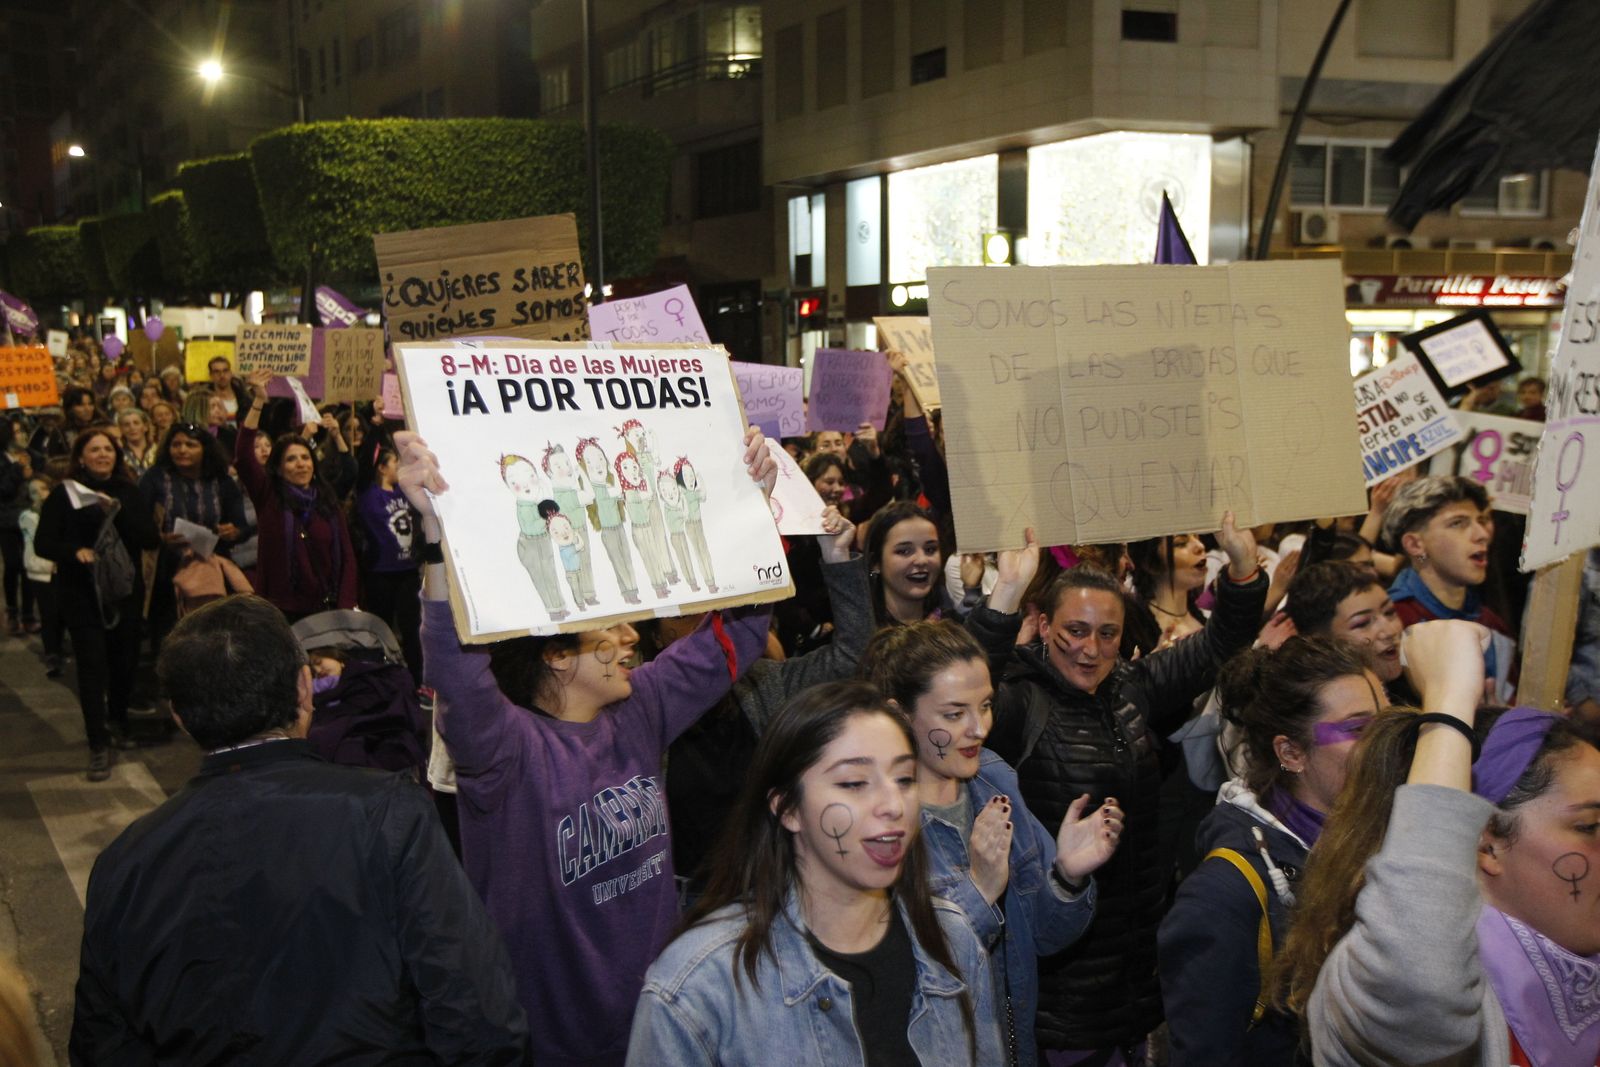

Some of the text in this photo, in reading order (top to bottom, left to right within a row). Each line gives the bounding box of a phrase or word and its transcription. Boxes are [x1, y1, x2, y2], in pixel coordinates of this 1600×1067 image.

[512, 262, 580, 293] SABER
[511, 291, 587, 326] SOMOS
[942, 280, 1069, 330] SOMOS
[1083, 296, 1137, 328] LAS
[249, 343, 273, 351] CASA
[605, 319, 658, 342] TODAS
[440, 354, 703, 378] 8-M: Día de las Mujeres
[990, 345, 1304, 384] DE LAS BRUJAS QUE
[446, 379, 490, 416] ¡A
[497, 377, 581, 414] POR
[584, 376, 712, 412] TODAS!
[1016, 406, 1061, 452] NO
[1050, 455, 1253, 526] QUEMAR
